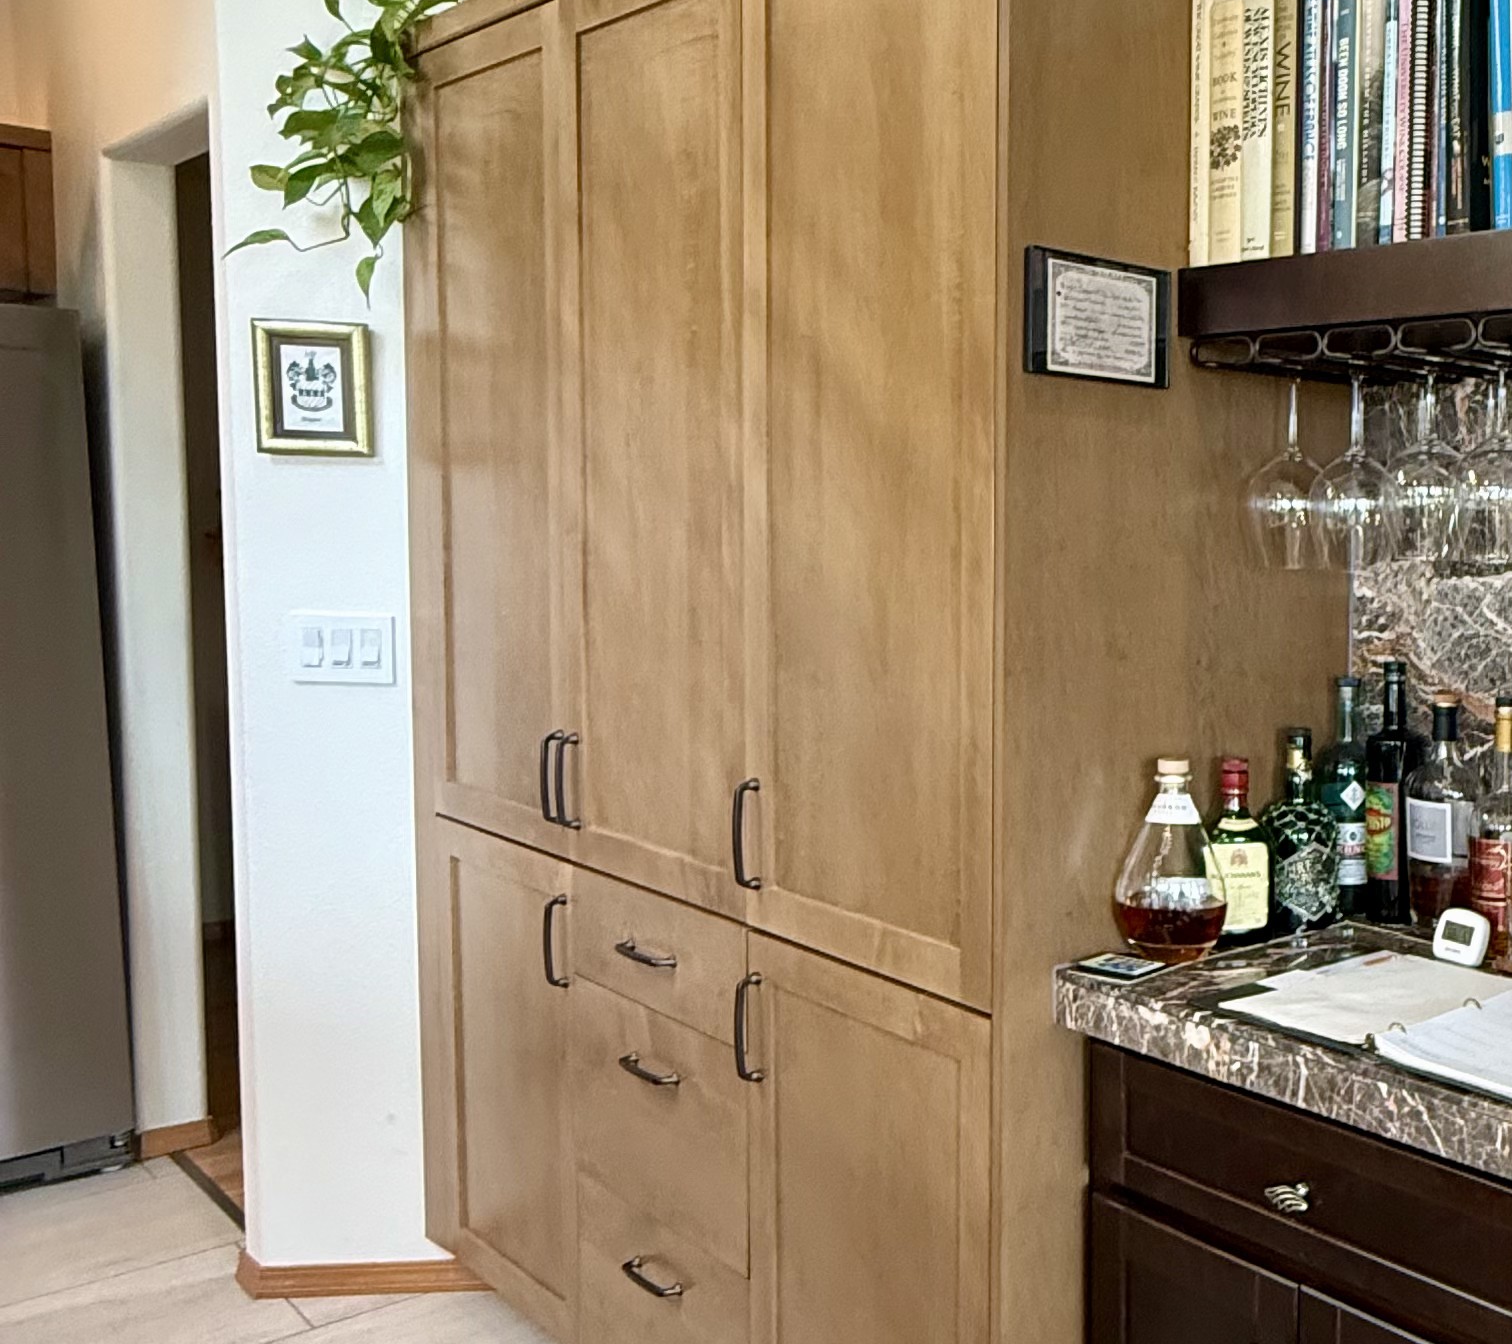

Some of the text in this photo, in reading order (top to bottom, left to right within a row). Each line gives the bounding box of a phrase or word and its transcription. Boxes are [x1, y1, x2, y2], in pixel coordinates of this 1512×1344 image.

[1338, 37, 1350, 67] BEEN
[1275, 41, 1292, 117] WINE
[1336, 102, 1348, 119] SO
[1336, 119, 1348, 151] LONG
